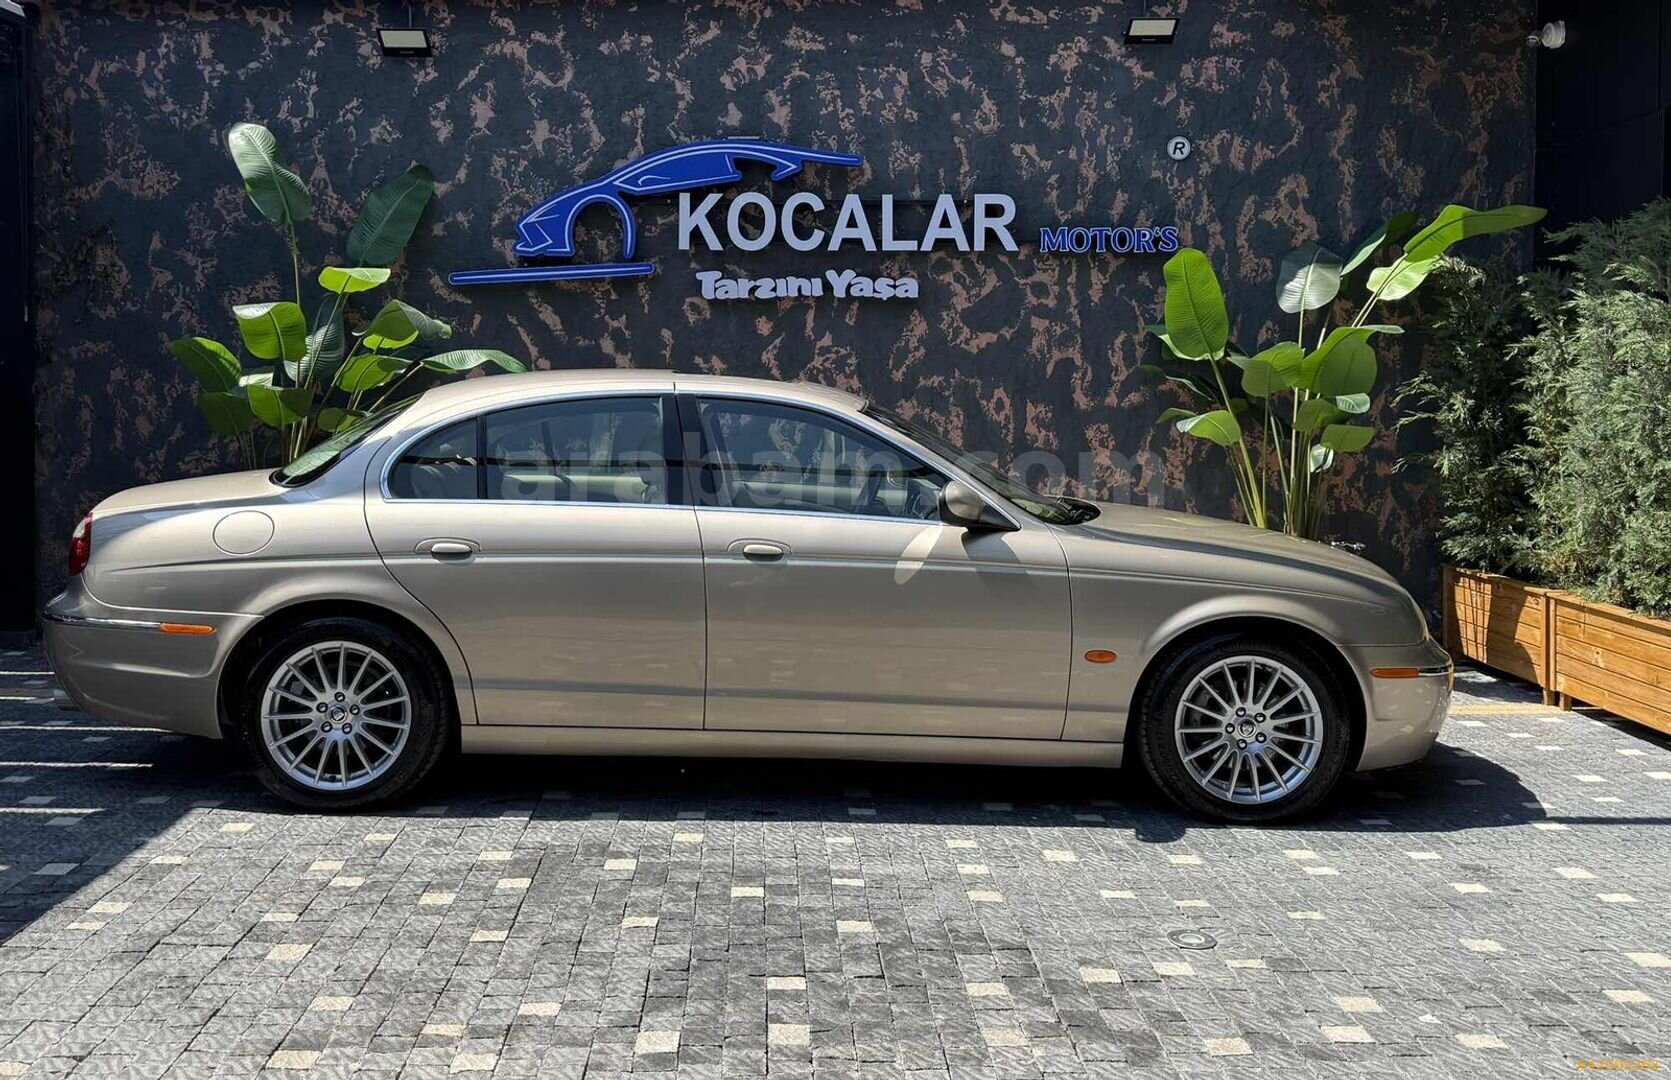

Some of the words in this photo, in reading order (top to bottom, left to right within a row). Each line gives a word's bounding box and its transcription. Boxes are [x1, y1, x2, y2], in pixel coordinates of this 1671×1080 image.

[678, 192, 1019, 251] KOCALAR
[695, 270, 823, 300] Tarzını
[825, 269, 919, 300] Yaşa
